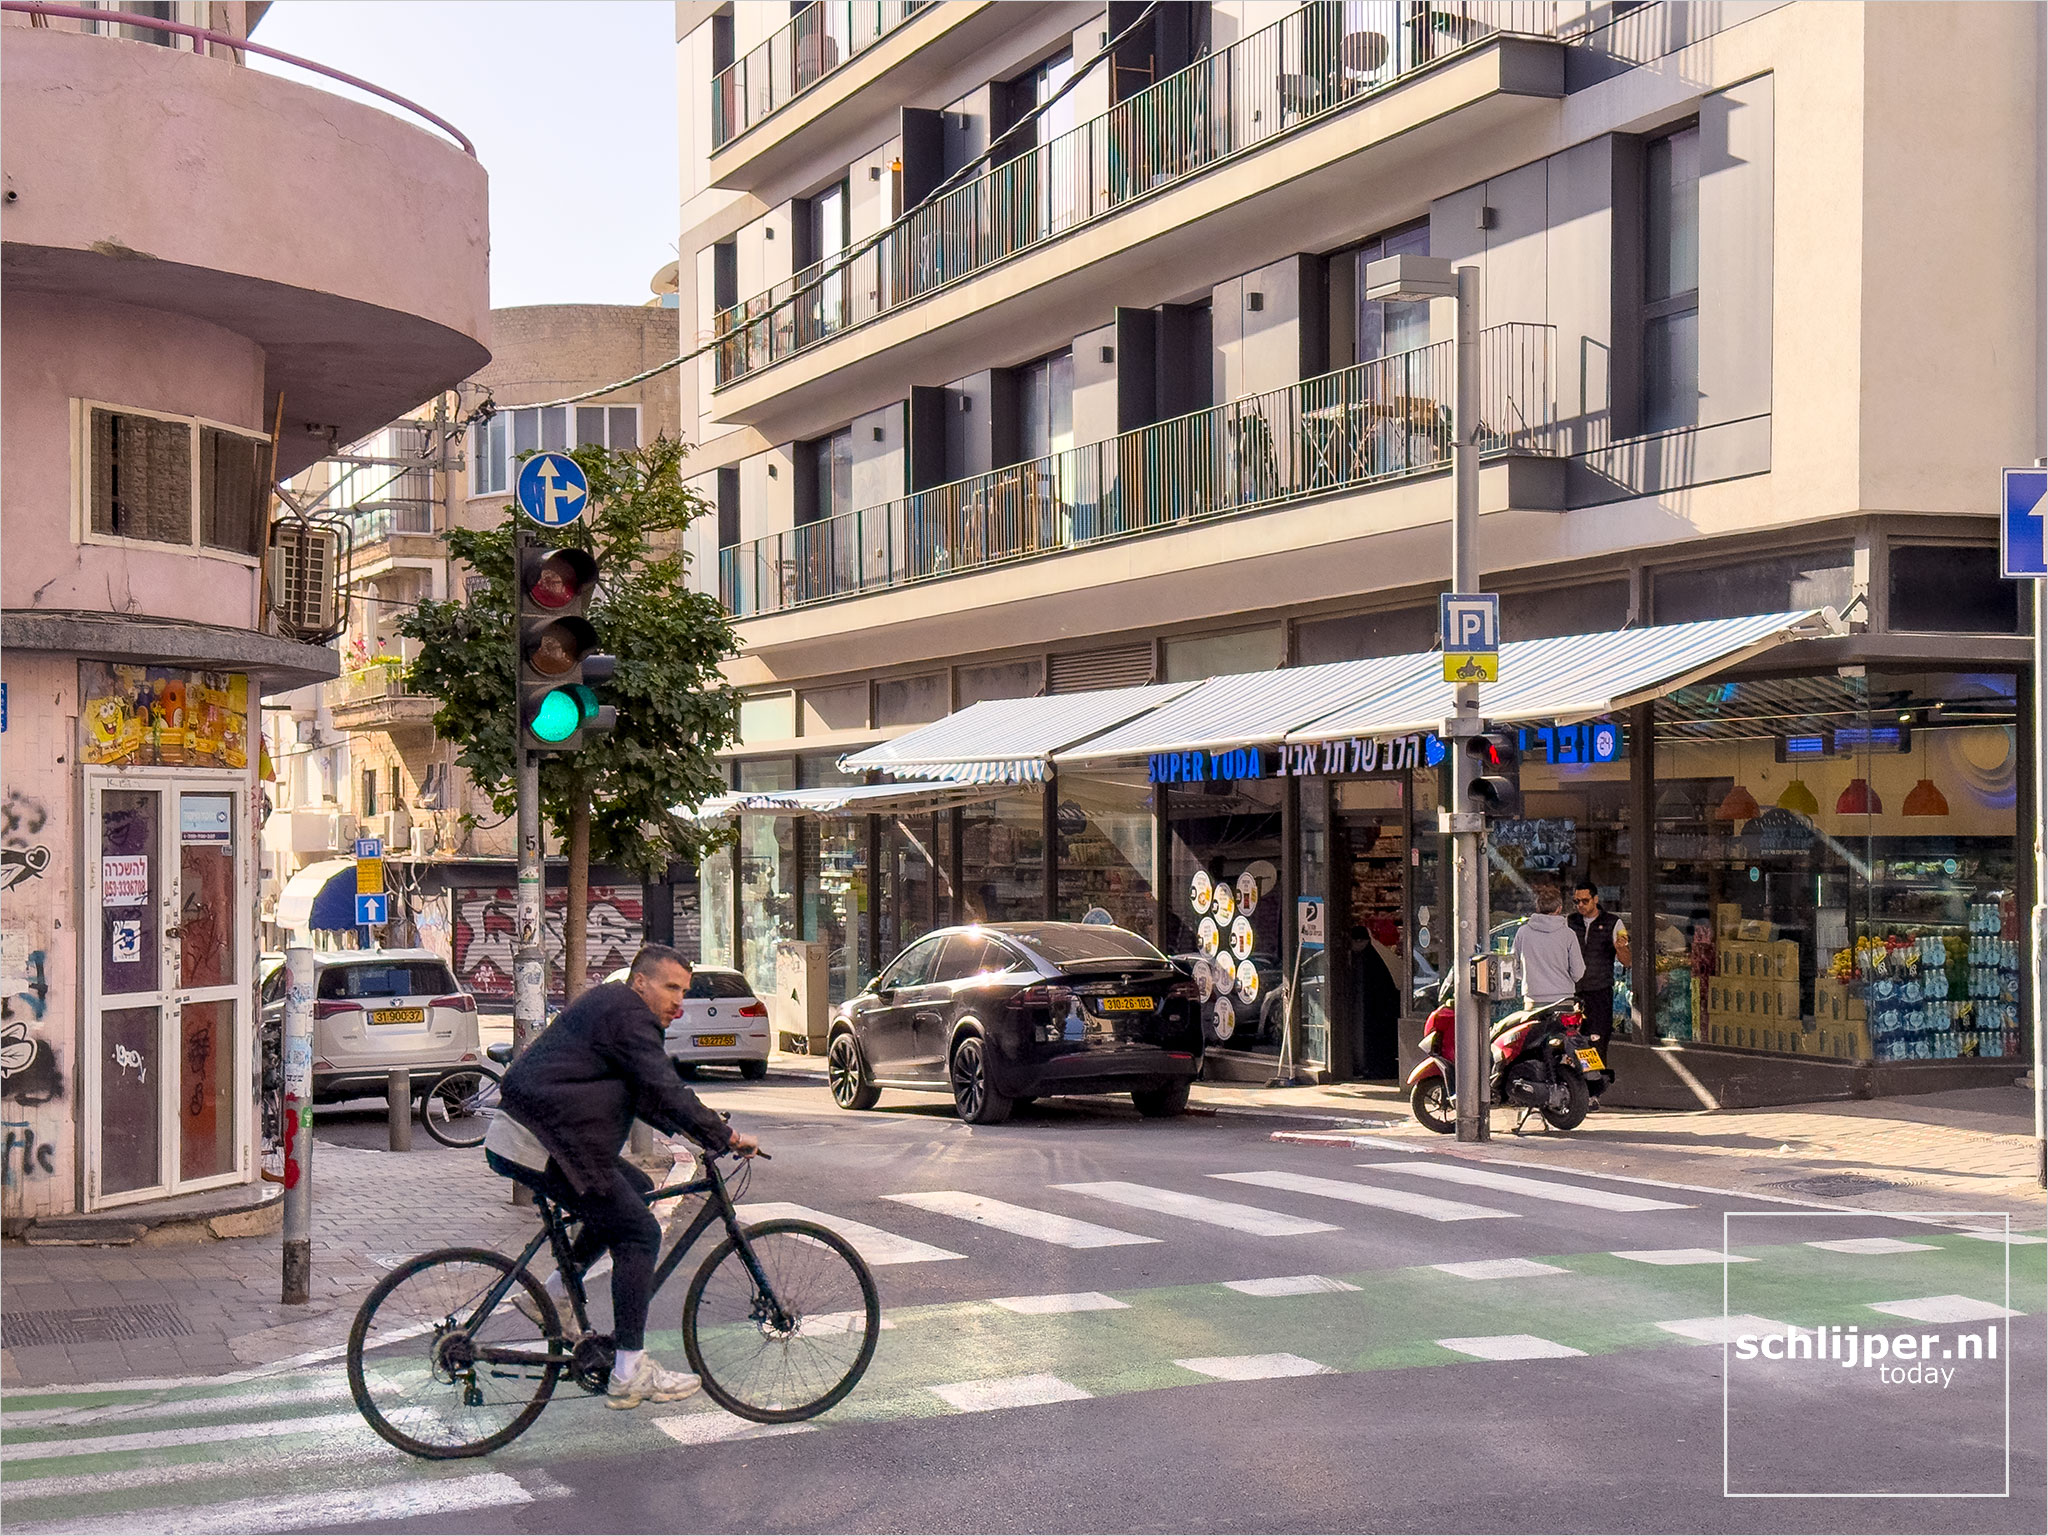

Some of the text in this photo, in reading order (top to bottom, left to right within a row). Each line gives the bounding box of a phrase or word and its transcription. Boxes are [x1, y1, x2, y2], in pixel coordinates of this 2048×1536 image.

[1462, 613, 1481, 646] P
[1148, 747, 1261, 783] SUPER YUDA
[1276, 735, 1421, 777] הלב של תל אביב
[526, 835, 536, 851] 5
[105, 857, 146, 877] להשכרה
